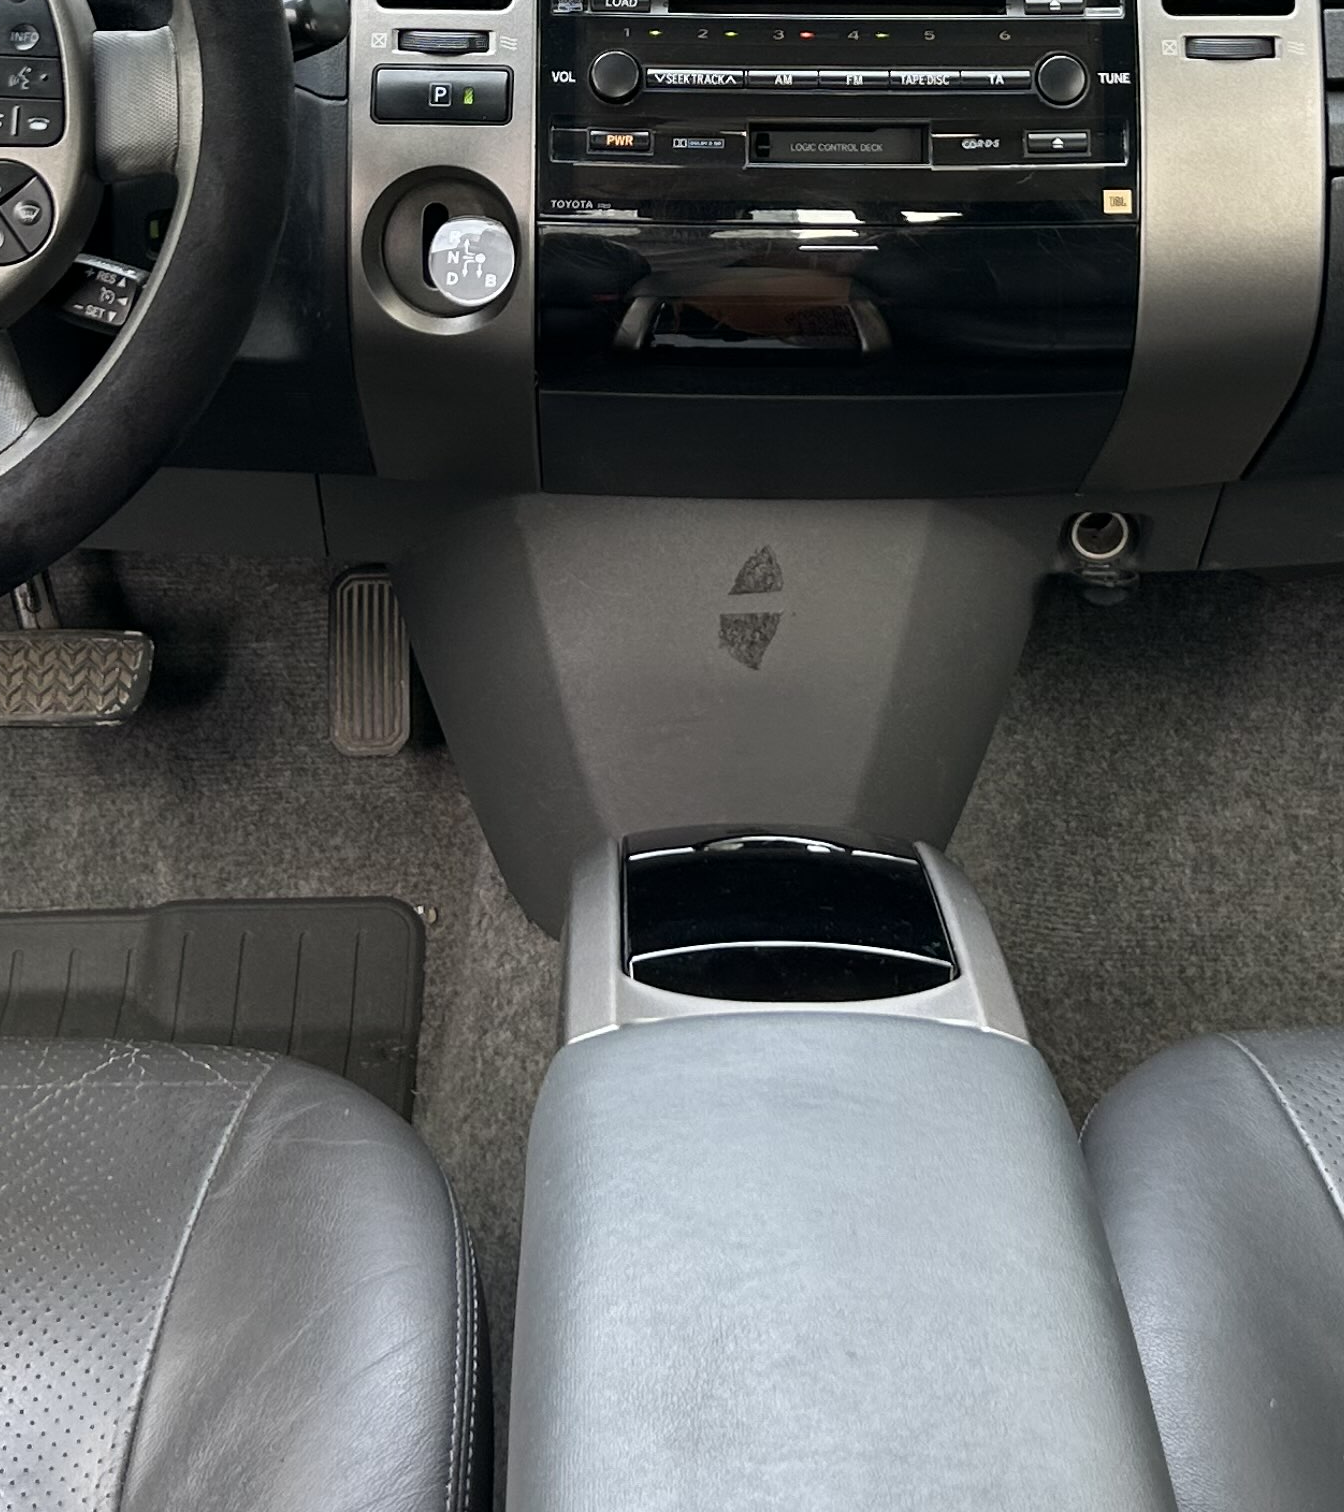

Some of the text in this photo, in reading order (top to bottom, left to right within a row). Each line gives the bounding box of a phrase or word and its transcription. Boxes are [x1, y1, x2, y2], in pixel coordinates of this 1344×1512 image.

[623, 27, 1011, 40] 1 2 3 4 5 6
[551, 70, 577, 83] VOL
[774, 74, 793, 86] AM
[846, 74, 863, 86] FM
[988, 74, 1005, 86] TA
[1097, 71, 1131, 85] TUNE
[434, 87, 447, 103] P
[606, 134, 634, 146] PWR
[790, 143, 883, 153] LOGIC CONTROL DECK
[550, 199, 594, 209] TOYOTA
[447, 250, 460, 264] N
[96, 270, 117, 285] RES
[446, 271, 497, 287] D B
[84, 304, 106, 319] SET
